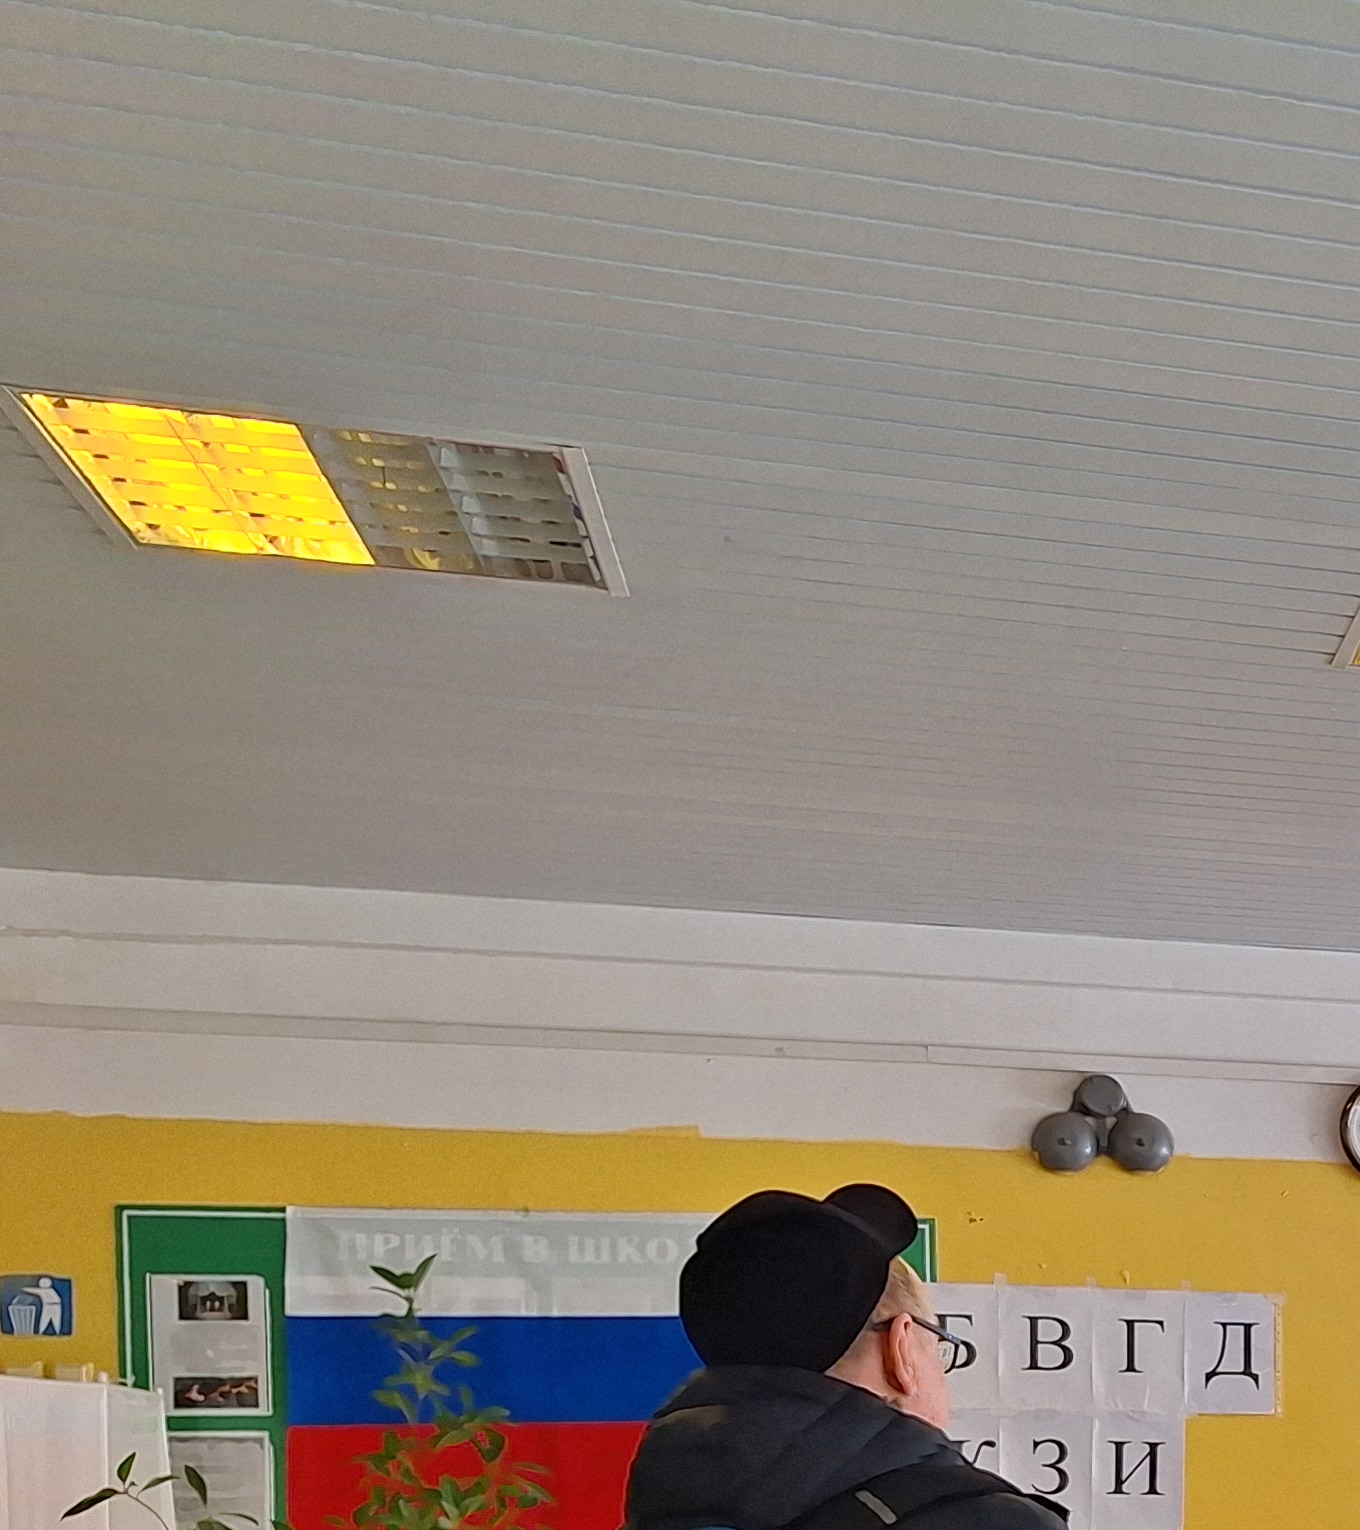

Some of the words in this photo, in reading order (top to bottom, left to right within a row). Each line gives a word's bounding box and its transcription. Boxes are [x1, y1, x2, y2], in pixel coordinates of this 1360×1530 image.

[567, 1233, 698, 1265] ШКО
[1022, 1315, 1074, 1371] В
[1118, 1318, 1165, 1374] Г
[1204, 1321, 1261, 1391] Д
[1030, 1438, 1070, 1496] З
[1106, 1440, 1167, 1496] И
